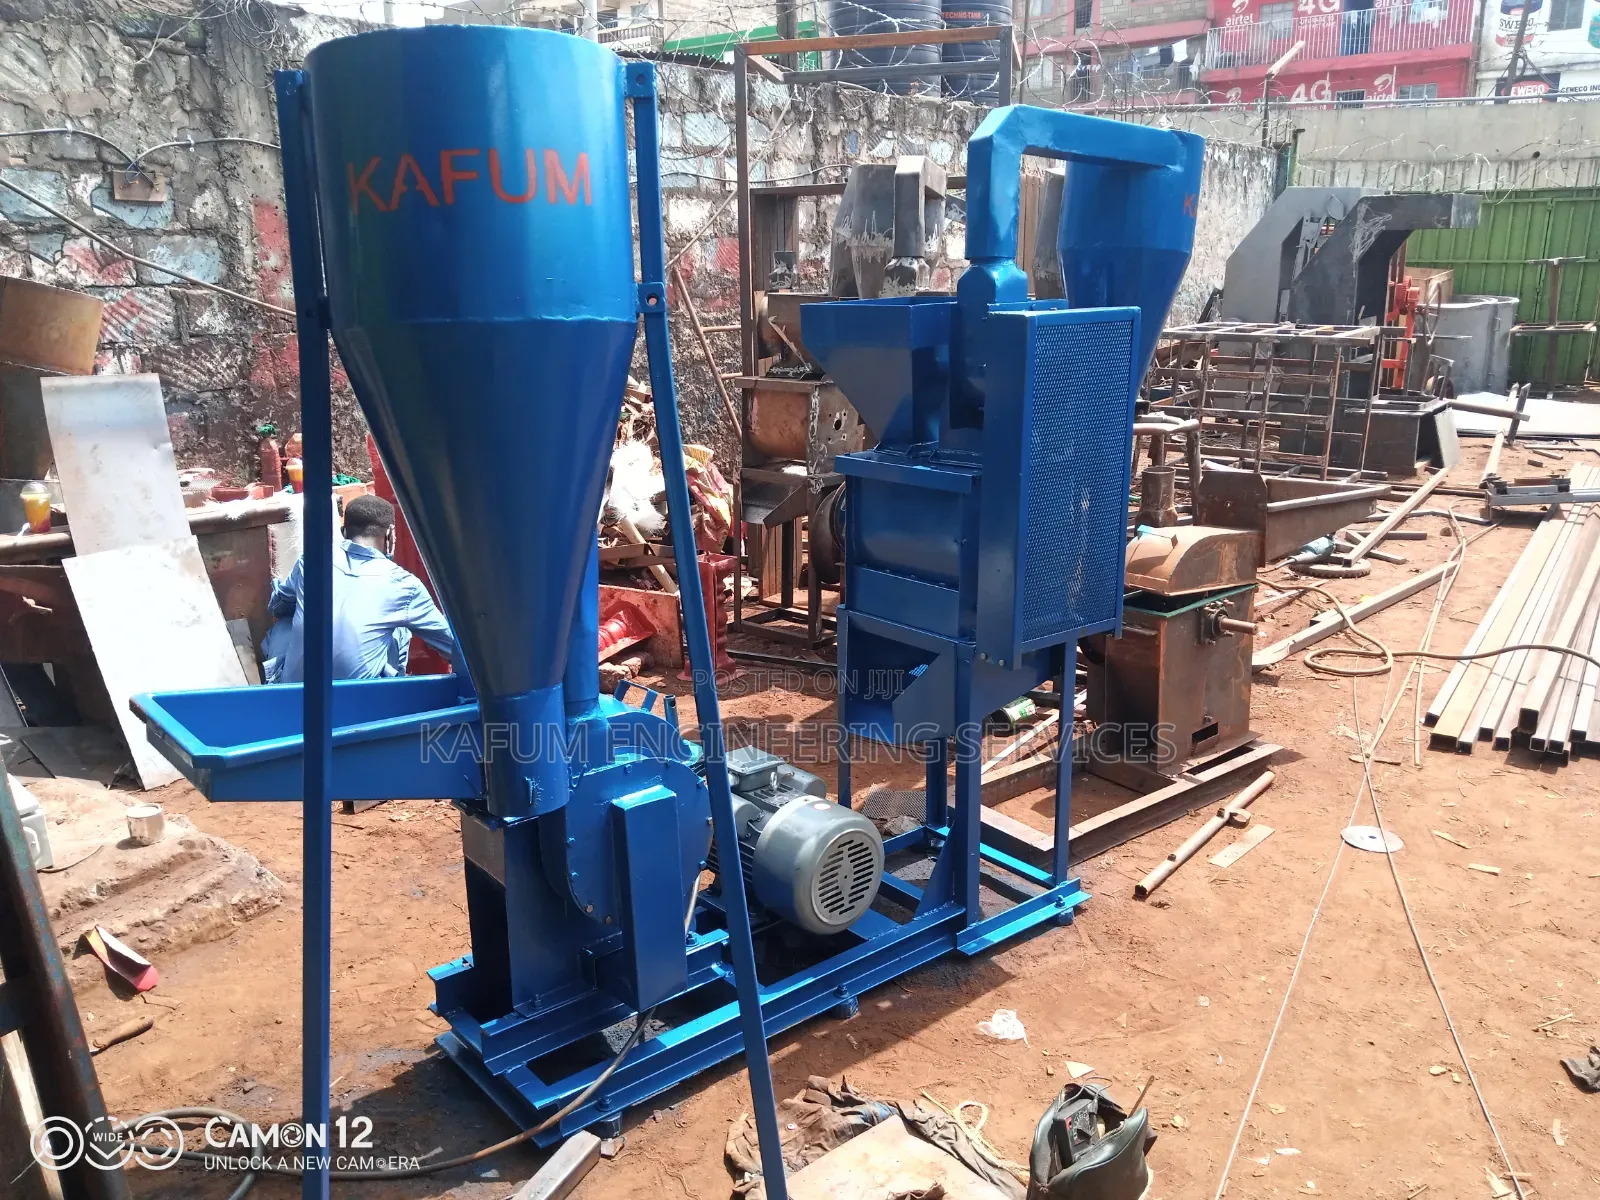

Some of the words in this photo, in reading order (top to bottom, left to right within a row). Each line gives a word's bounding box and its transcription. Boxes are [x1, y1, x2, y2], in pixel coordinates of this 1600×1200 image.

[1225, 13, 1253, 26] airtel
[1500, 18, 1534, 29] SWEO
[1290, 80, 1331, 102] 4G
[1505, 84, 1545, 96] EWECO
[346, 148, 592, 215] KAFUM
